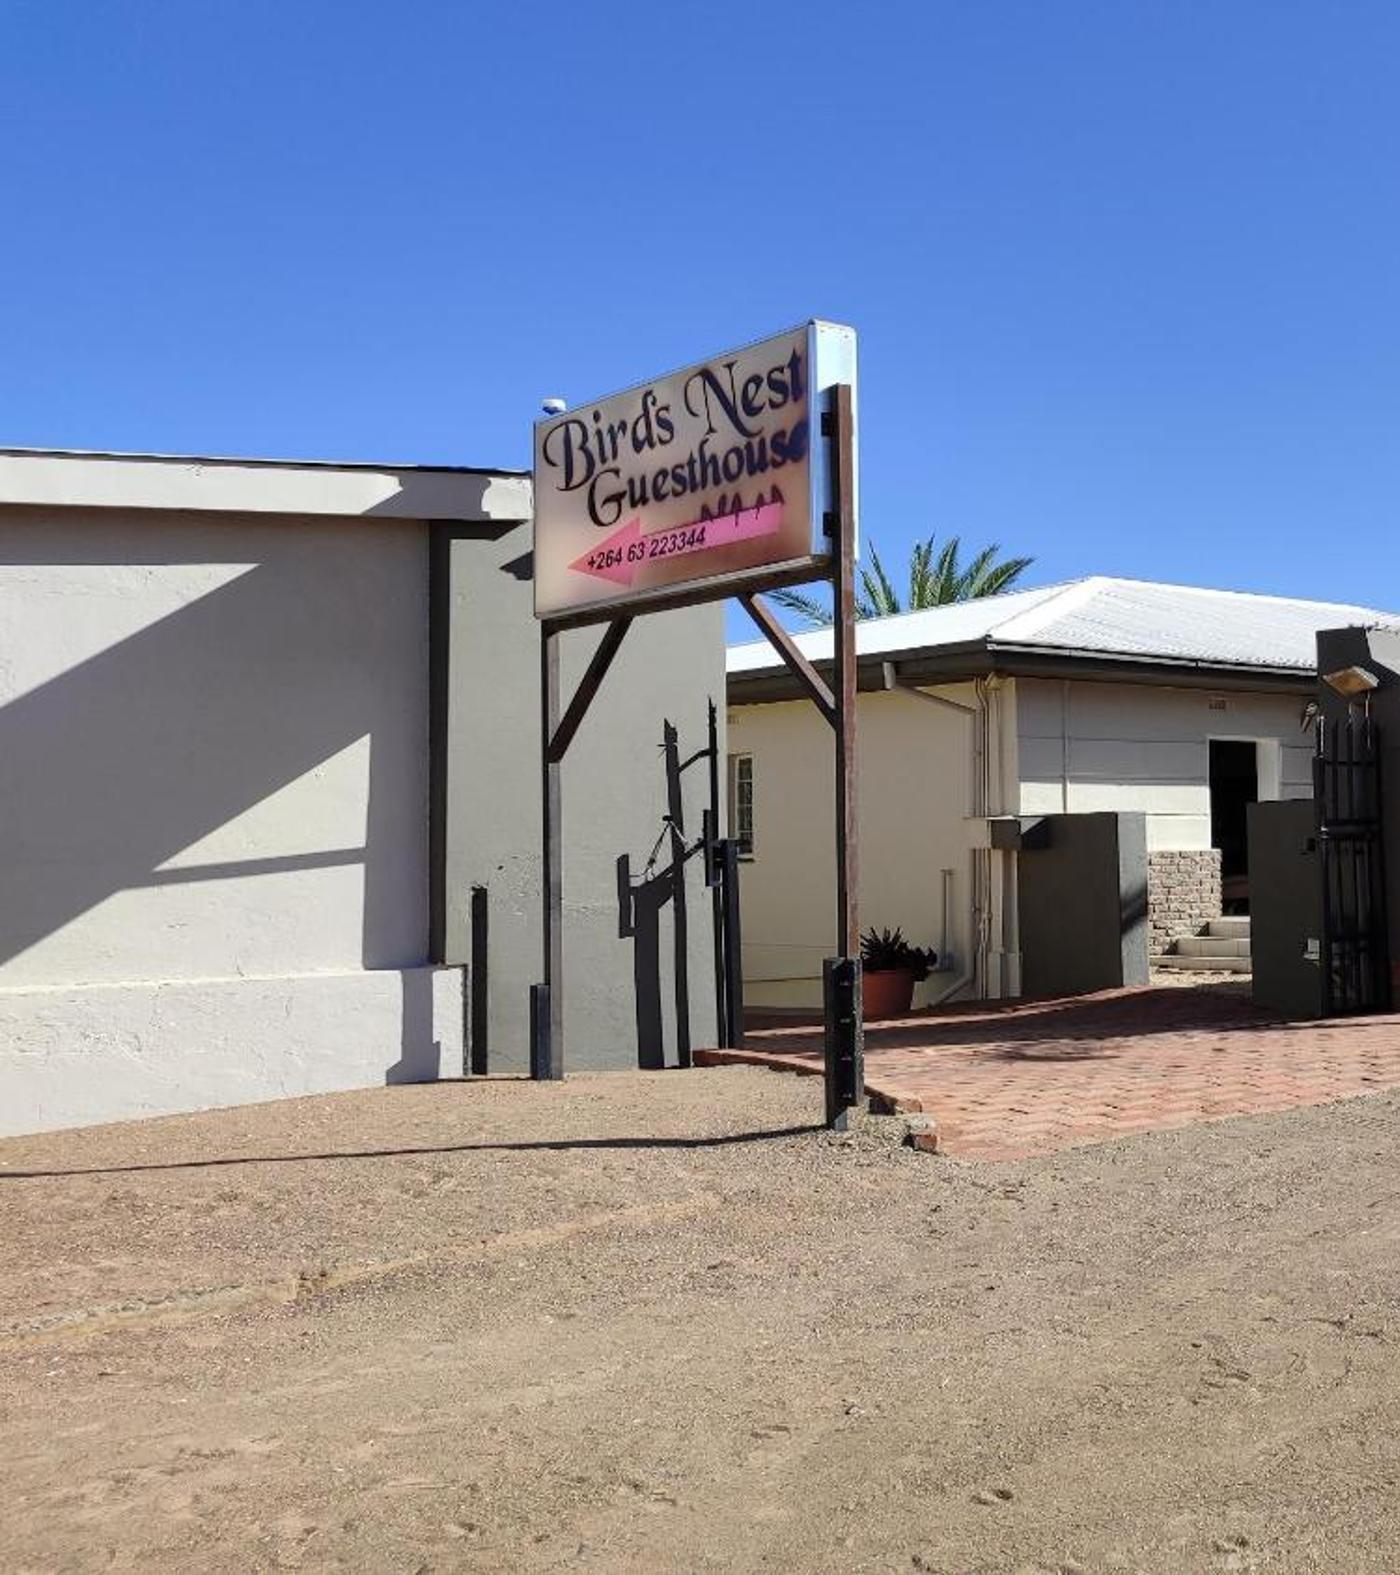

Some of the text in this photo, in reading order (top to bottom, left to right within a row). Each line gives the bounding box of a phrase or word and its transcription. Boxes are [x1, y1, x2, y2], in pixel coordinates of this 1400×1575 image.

[543, 348, 804, 491] Bird's Nest
[587, 419, 809, 527] Guesthouse
[587, 527, 706, 570] +264 63 223344
